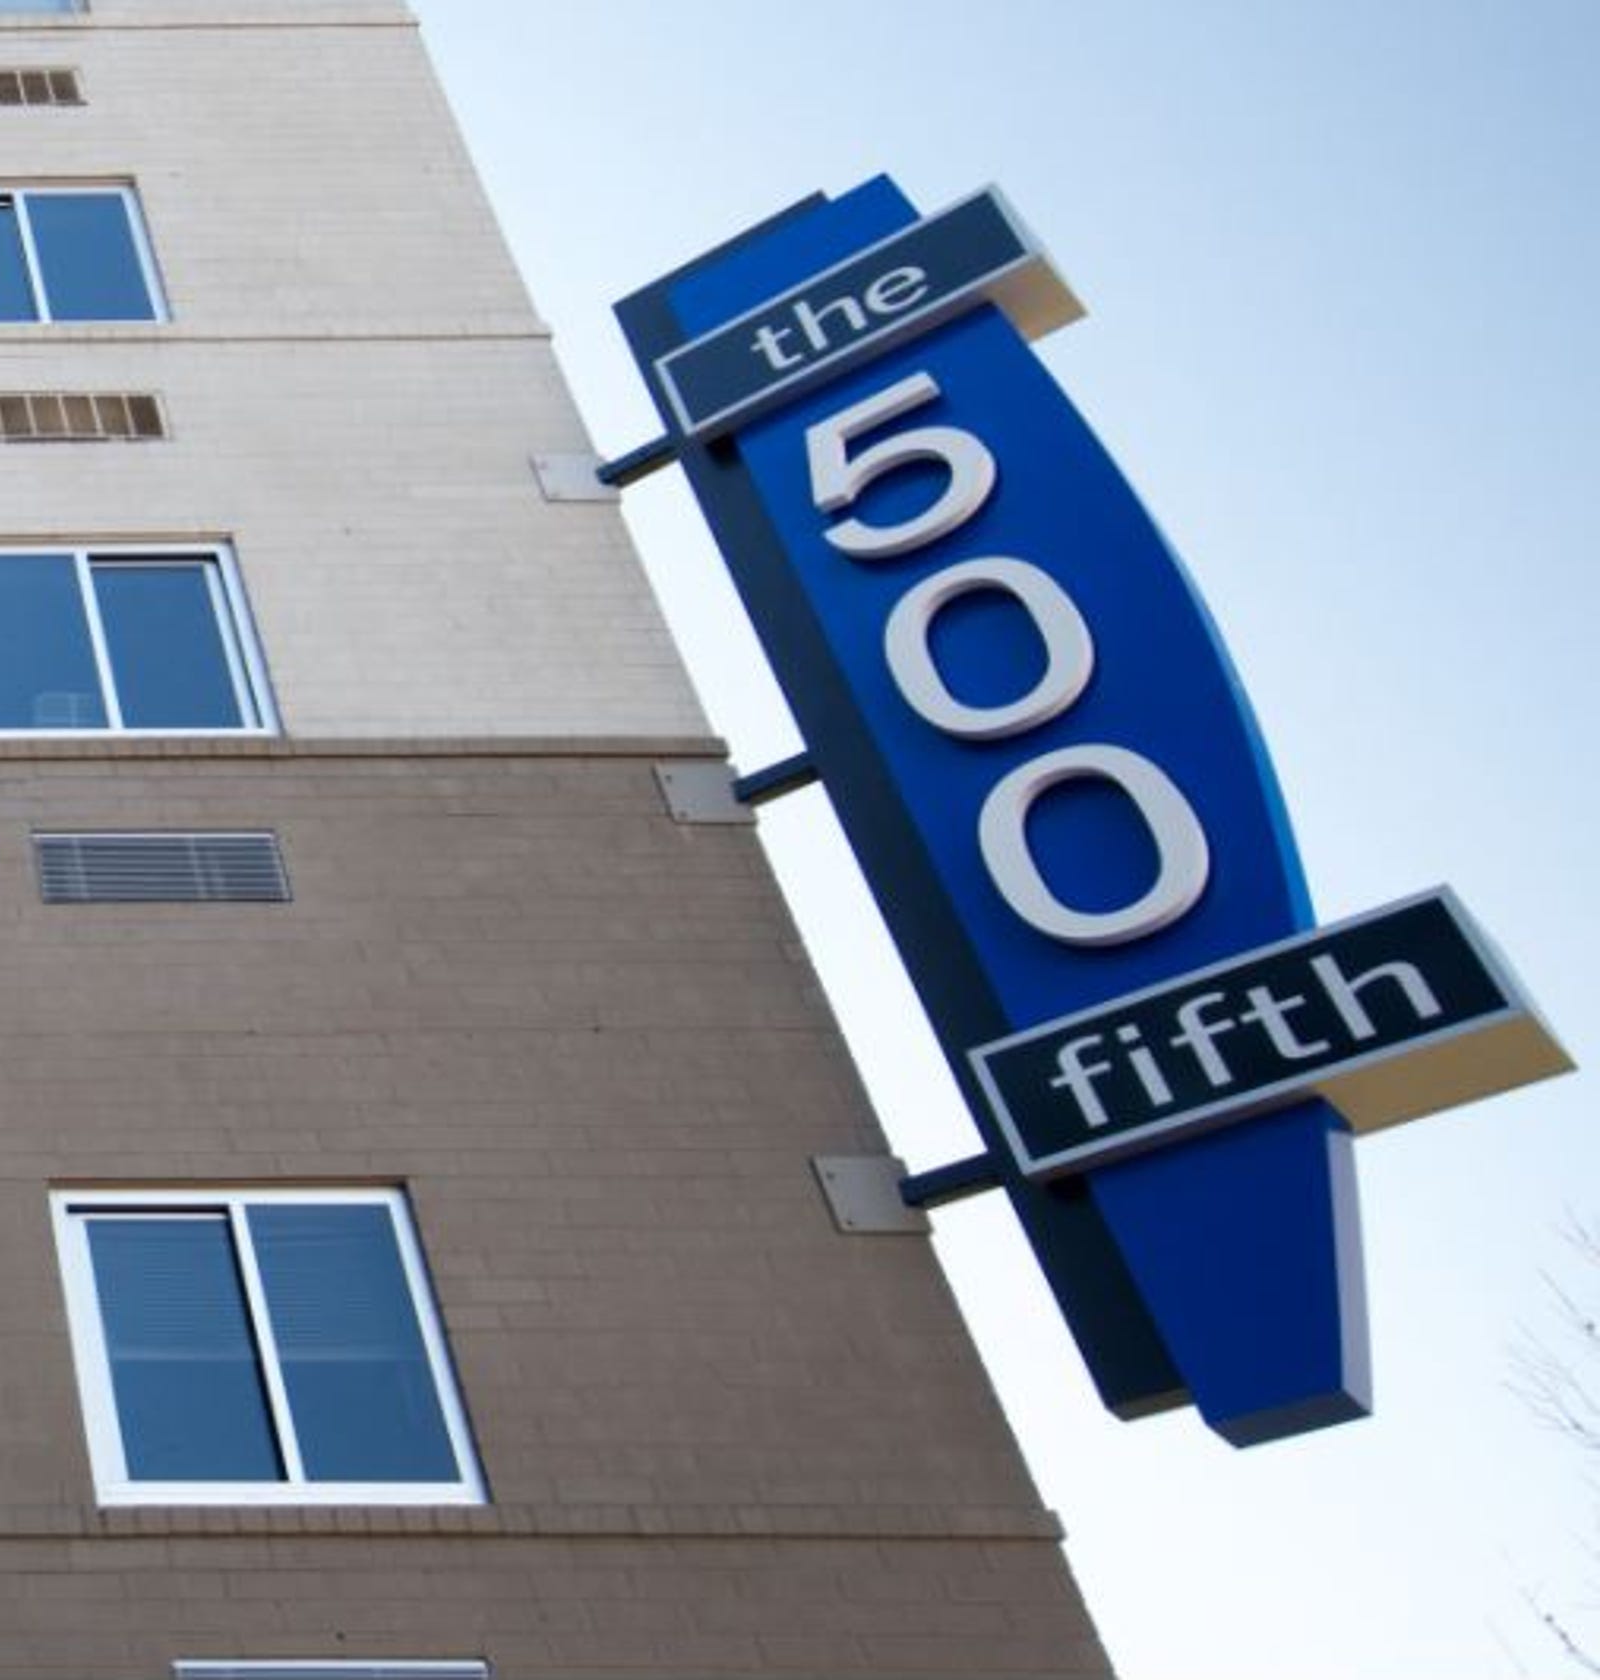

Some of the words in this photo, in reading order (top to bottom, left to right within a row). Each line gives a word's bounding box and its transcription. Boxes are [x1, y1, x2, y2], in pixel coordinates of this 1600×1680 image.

[750, 264, 930, 371] the
[805, 371, 1210, 947] 500
[1050, 953, 1443, 1130] fifth
